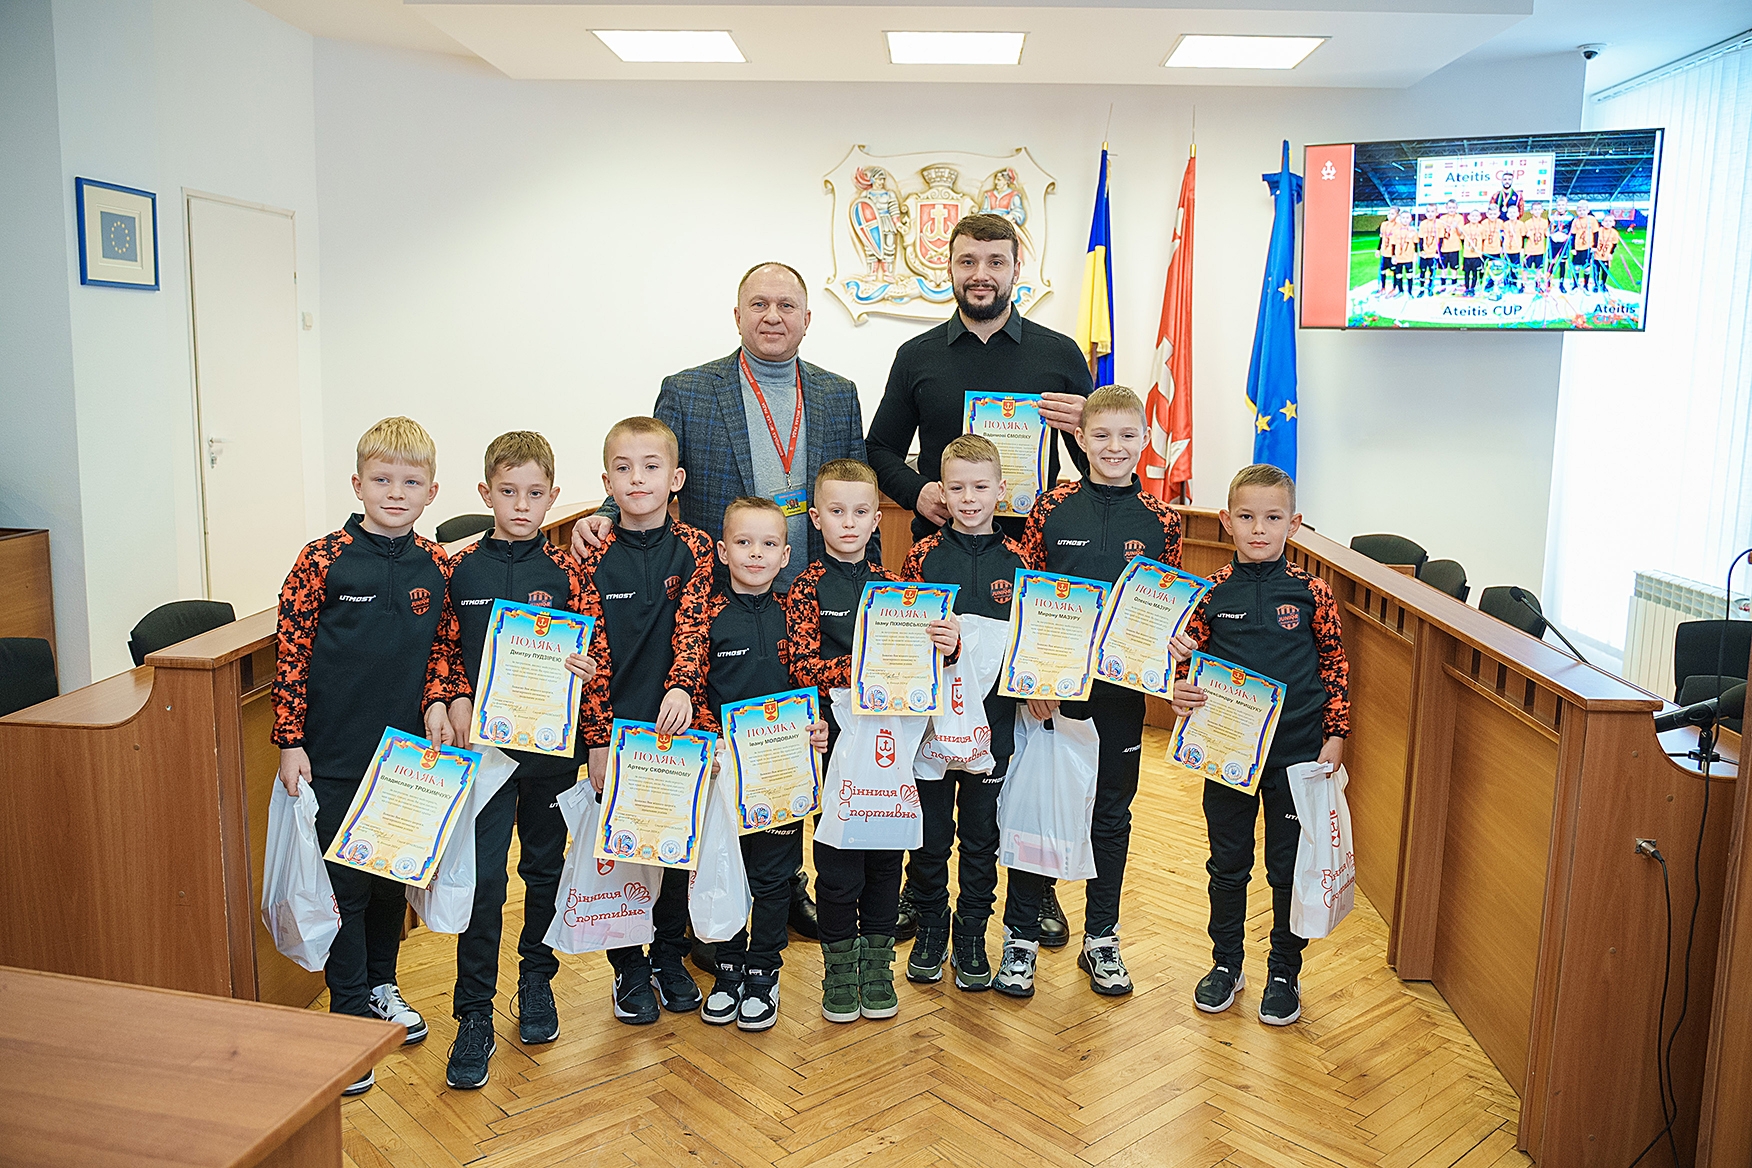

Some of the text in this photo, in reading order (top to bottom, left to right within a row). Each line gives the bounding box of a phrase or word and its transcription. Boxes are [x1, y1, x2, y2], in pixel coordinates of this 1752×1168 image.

[1445, 171, 1490, 182] Ateitis
[1443, 305, 1522, 316] Ateitis CUP
[1594, 303, 1636, 314] Ateitis
[983, 420, 1028, 431] ПОДЯКА
[1057, 539, 1090, 547] UTMOST
[339, 594, 376, 603] UTMOST
[1135, 584, 1176, 606] ПОДЯКА
[461, 598, 492, 606] UTMOST
[1035, 598, 1083, 613] ПОДЯКА
[820, 609, 850, 617] UTMOST
[879, 608, 928, 619] ПОДЯКА
[1217, 612, 1247, 620] UTMOST
[510, 635, 562, 654] ПОДЯКА
[509, 649, 531, 659] Дмитру
[717, 647, 750, 657] UTMOST
[1209, 679, 1257, 703] ПОДЯКА
[747, 721, 797, 738] ПОДЯКА
[633, 751, 686, 767] ПОДЯКА
[393, 764, 445, 788] ПОДЯКА
[627, 763, 692, 778] Артему СКОРОМНОМУ
[839, 779, 898, 801] Вінниця
[837, 801, 918, 823] Спортивна
[565, 888, 622, 909] Вінниця
[563, 903, 646, 928] Спортивна
